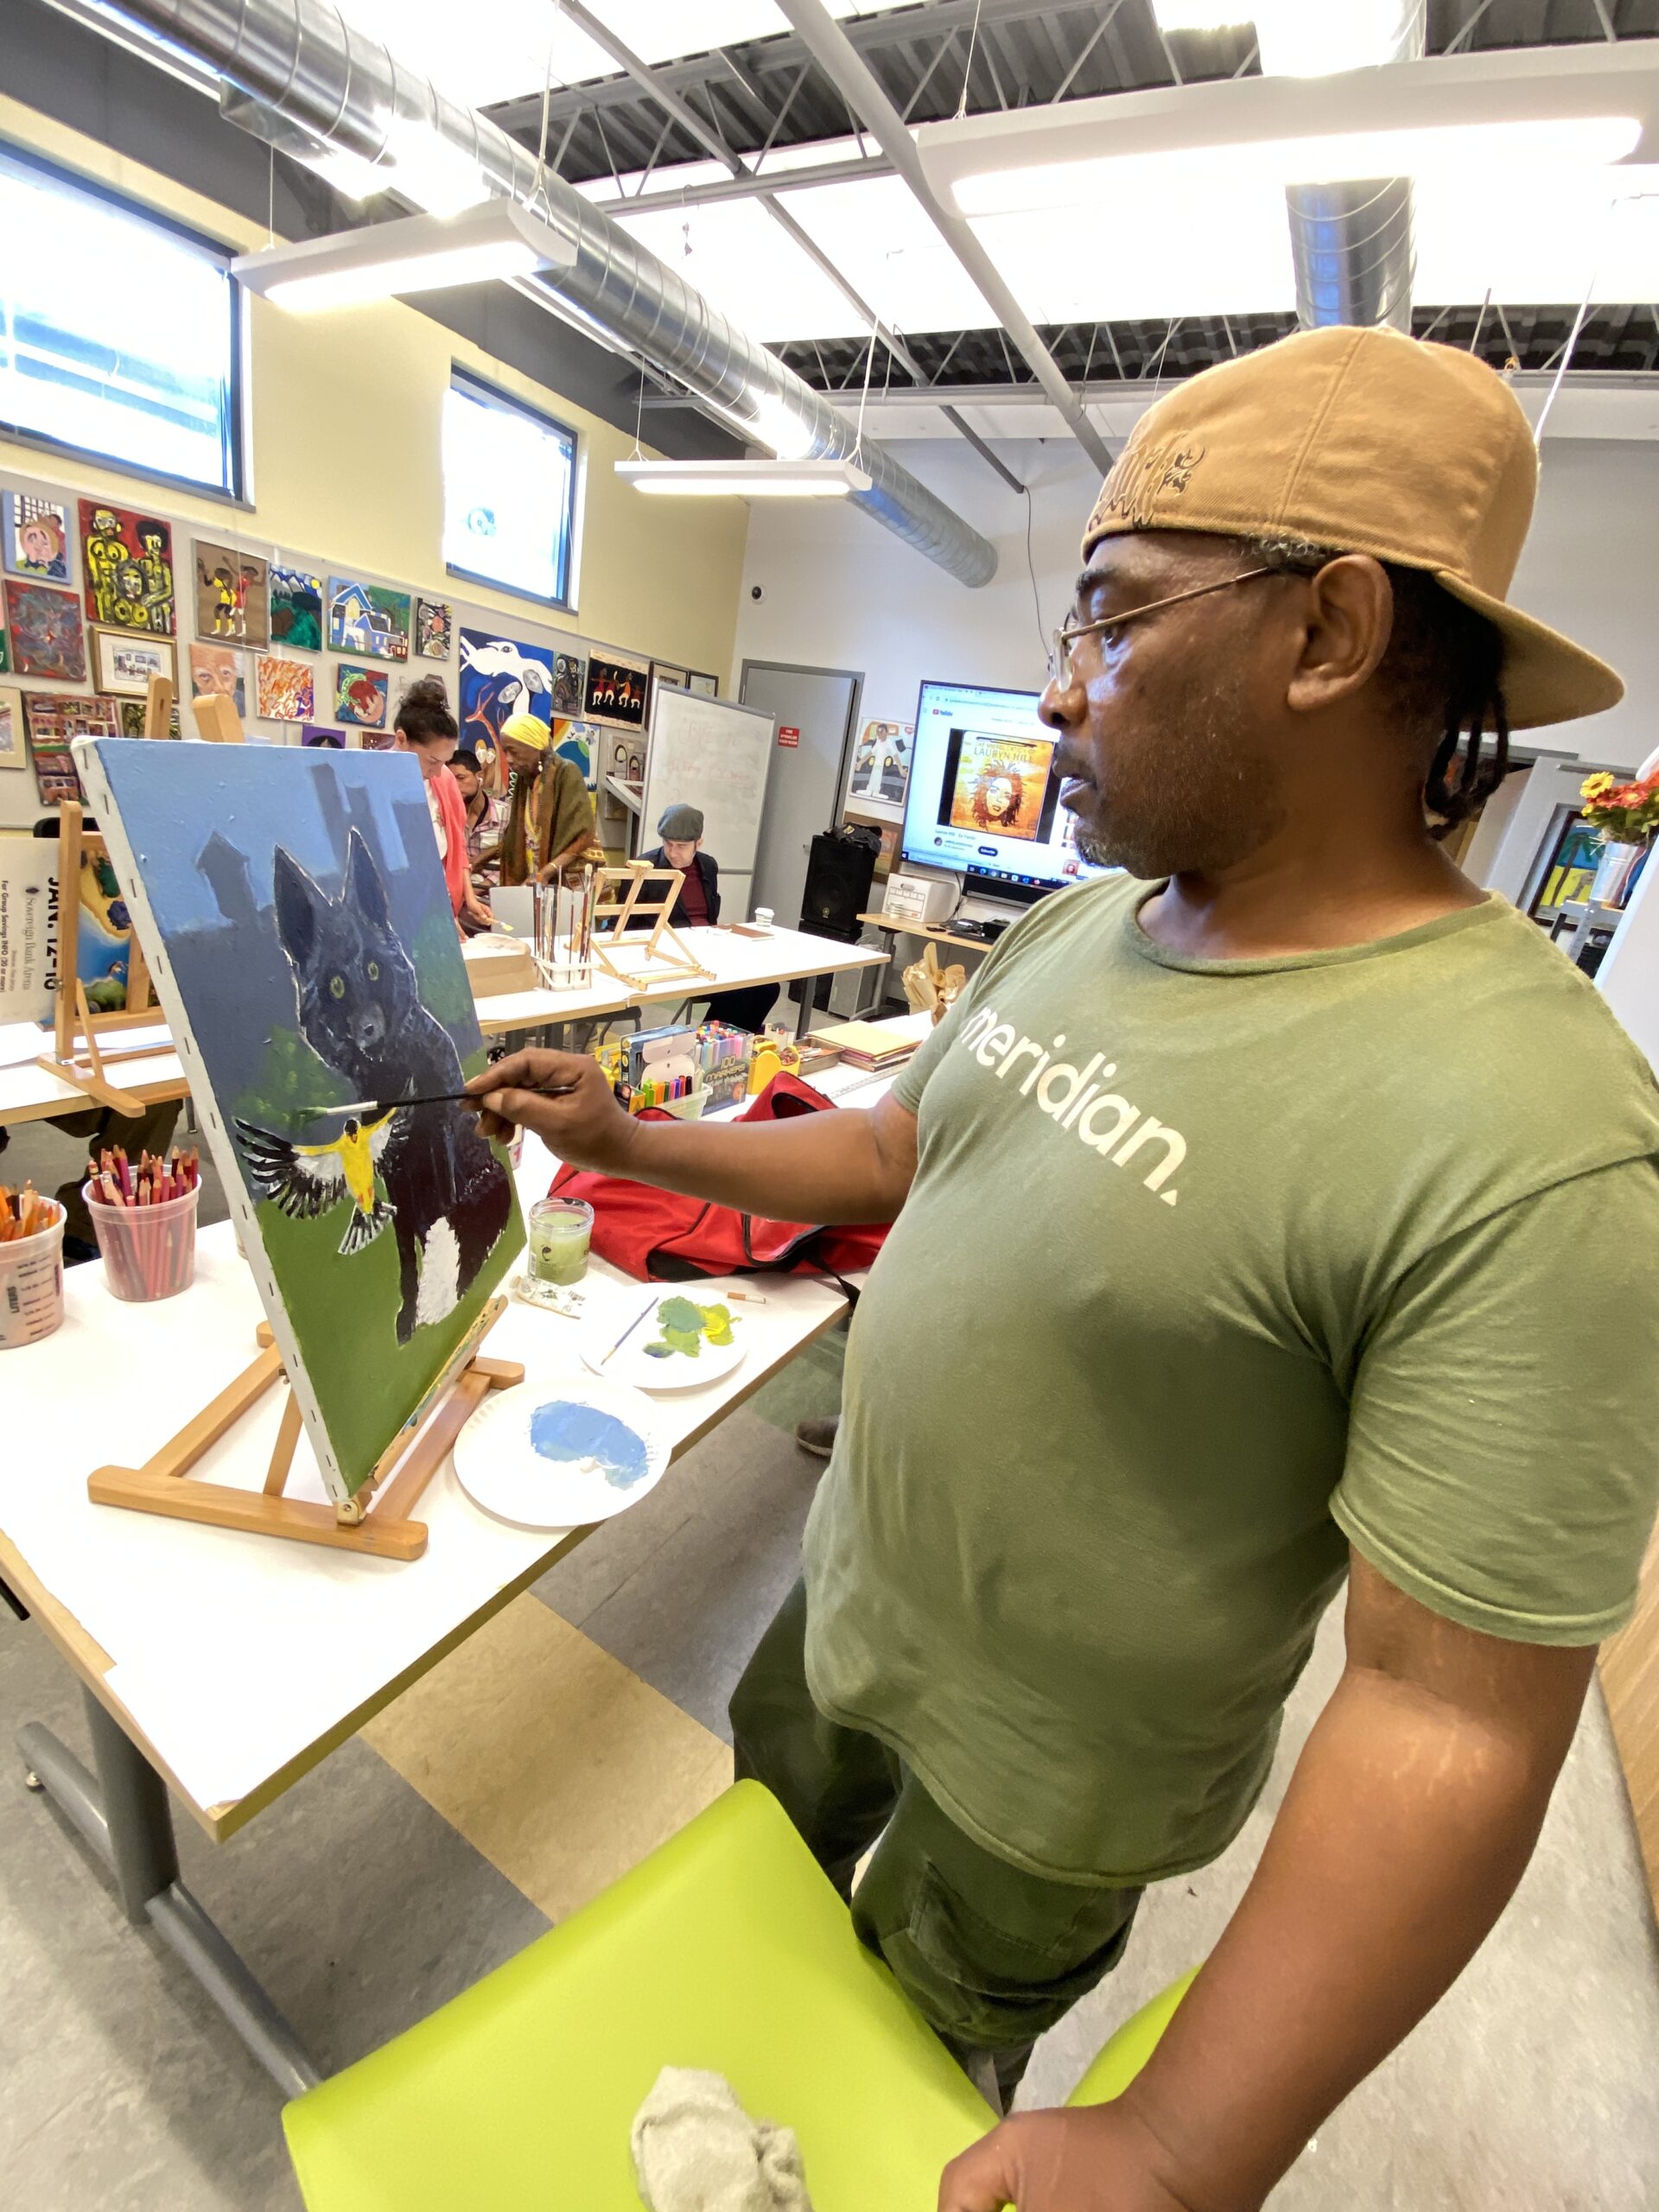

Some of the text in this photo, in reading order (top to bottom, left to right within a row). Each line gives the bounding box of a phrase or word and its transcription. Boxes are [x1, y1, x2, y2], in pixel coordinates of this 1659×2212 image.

[974, 747, 1033, 764] LAURYN HILL
[0, 893, 9, 912] Group
[22, 898, 36, 991] Sovereign Bank Arena
[721, 1055, 736, 1070] 100
[7, 1286, 20, 1313] LITERS
